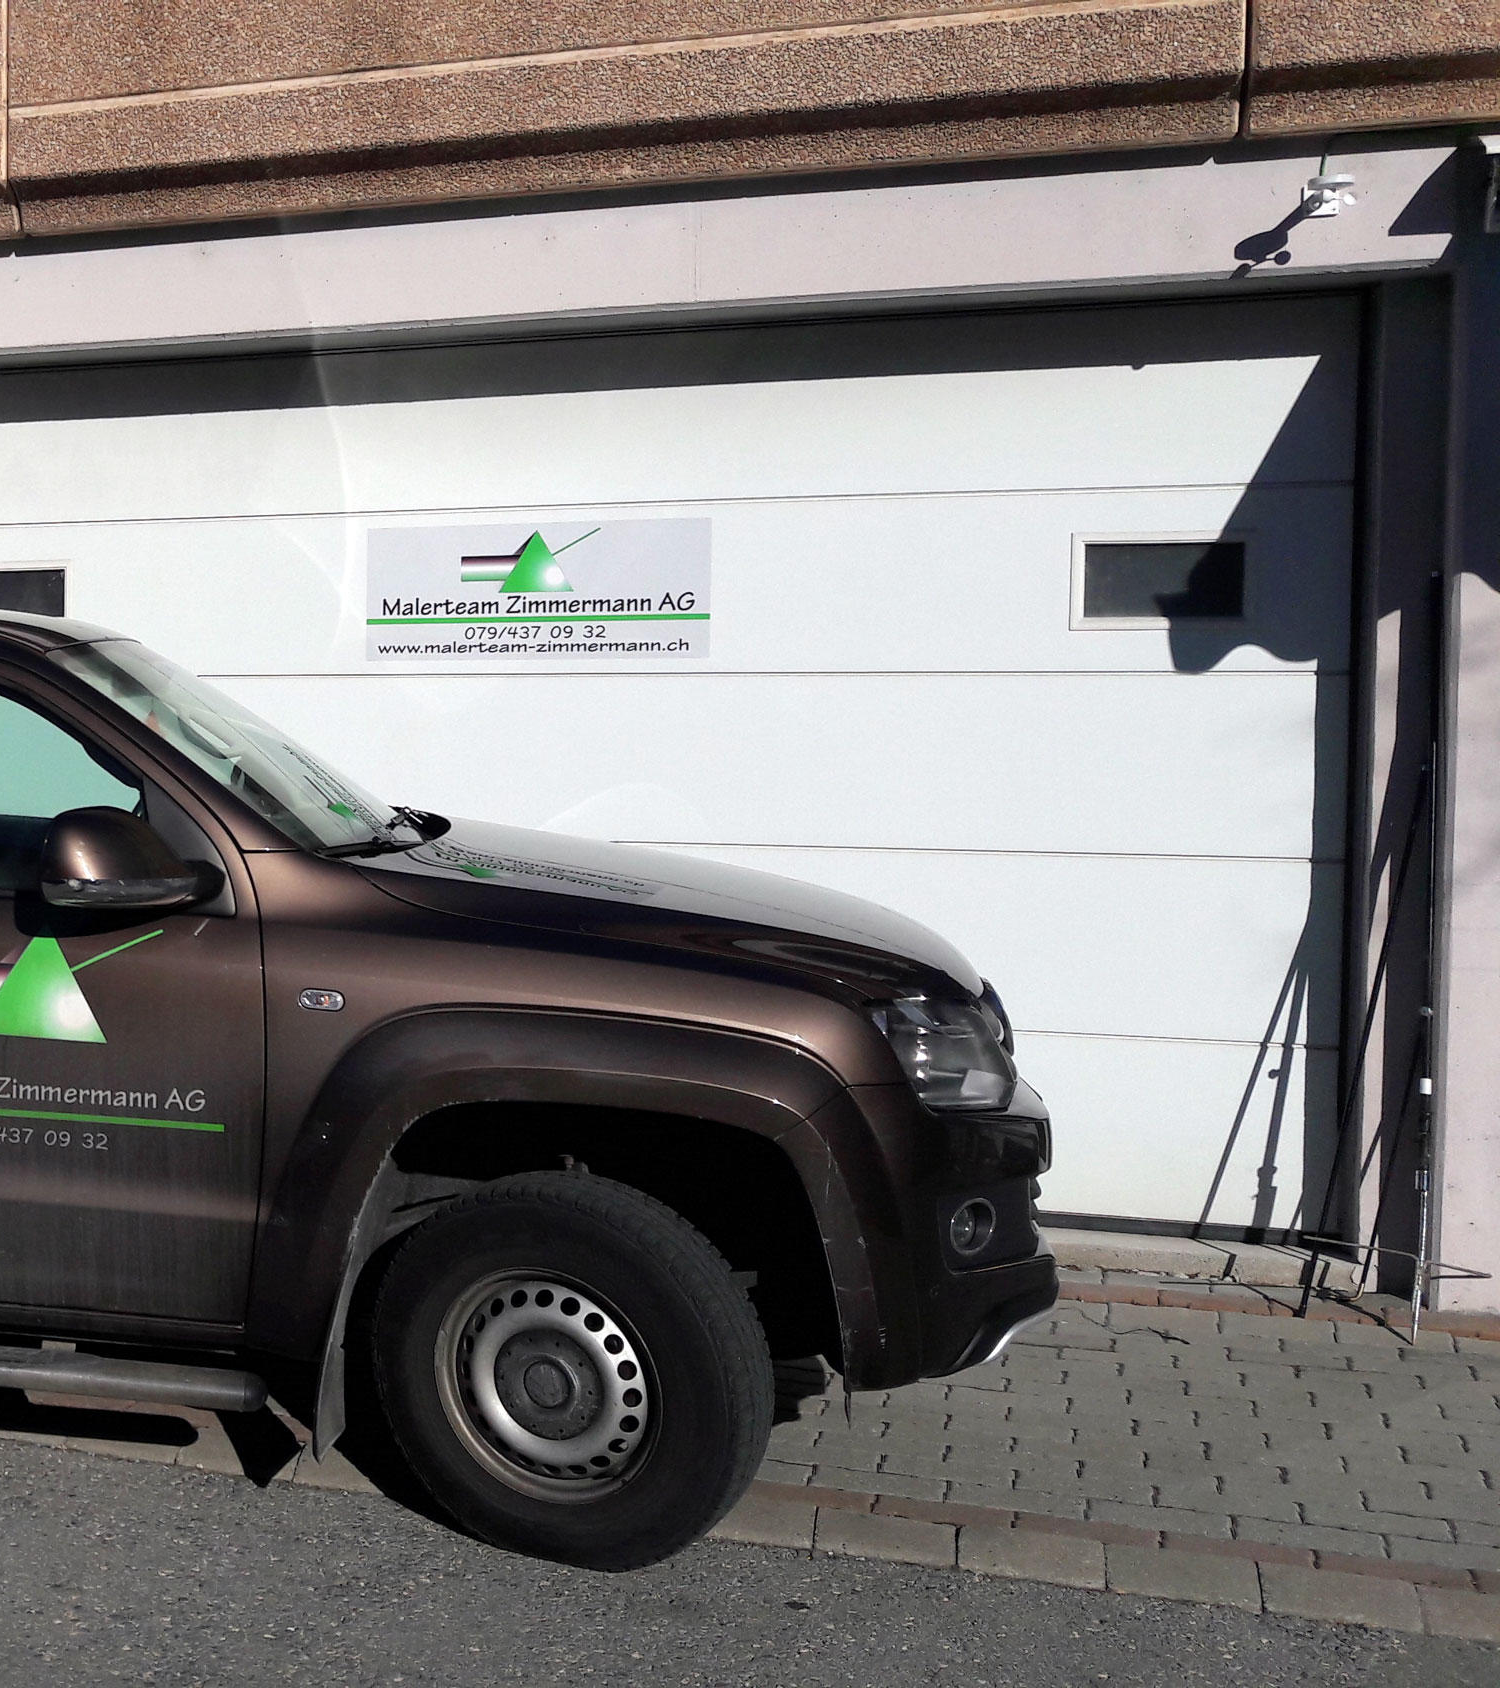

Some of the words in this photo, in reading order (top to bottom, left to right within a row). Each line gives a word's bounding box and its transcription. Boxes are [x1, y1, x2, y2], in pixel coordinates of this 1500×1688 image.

[382, 597, 500, 617] Malerteam
[505, 594, 652, 614] Zimmermann
[657, 591, 696, 612] AG
[464, 625, 542, 641] 079/437
[550, 625, 574, 639] 09
[582, 624, 607, 639] 32
[377, 638, 690, 655] www.malerteam-zimmermann.ch
[163, 1088, 206, 1112] AG
[44, 1130, 71, 1148] 09
[81, 1132, 109, 1151] 32
